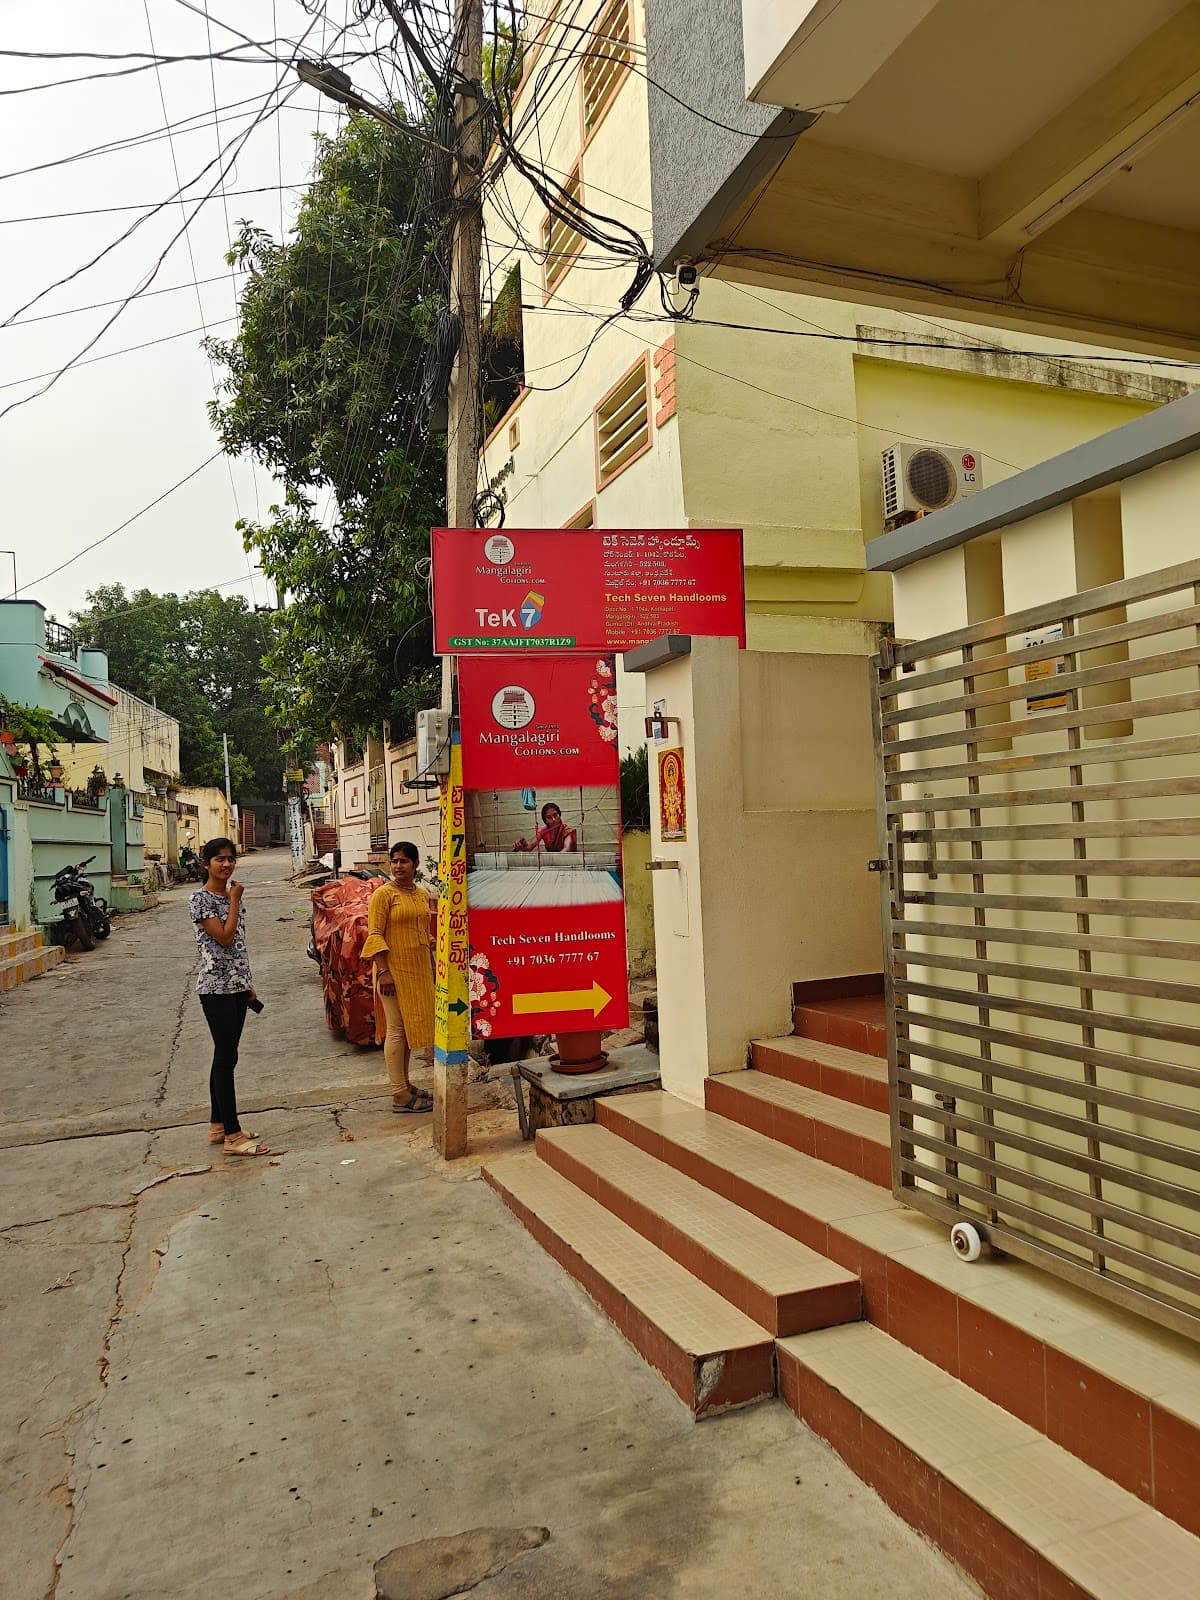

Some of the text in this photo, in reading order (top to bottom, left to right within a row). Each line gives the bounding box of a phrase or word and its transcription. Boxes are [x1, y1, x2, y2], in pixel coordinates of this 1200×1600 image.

[964, 473, 976, 482] LG
[603, 535, 618, 546] టెక్
[620, 535, 645, 546] సెవెన్
[475, 566, 532, 577] Mangalagiri
[605, 593, 727, 602] Tech Seven Handlooms
[475, 608, 536, 627] TeK 7
[454, 638, 472, 646] GST
[475, 638, 489, 646] No:
[480, 730, 560, 747] Mangalagiri
[451, 834, 464, 857] 7
[490, 931, 616, 945] Tech Seven Handlooms
[506, 951, 600, 966] +91 7036 7777 67
